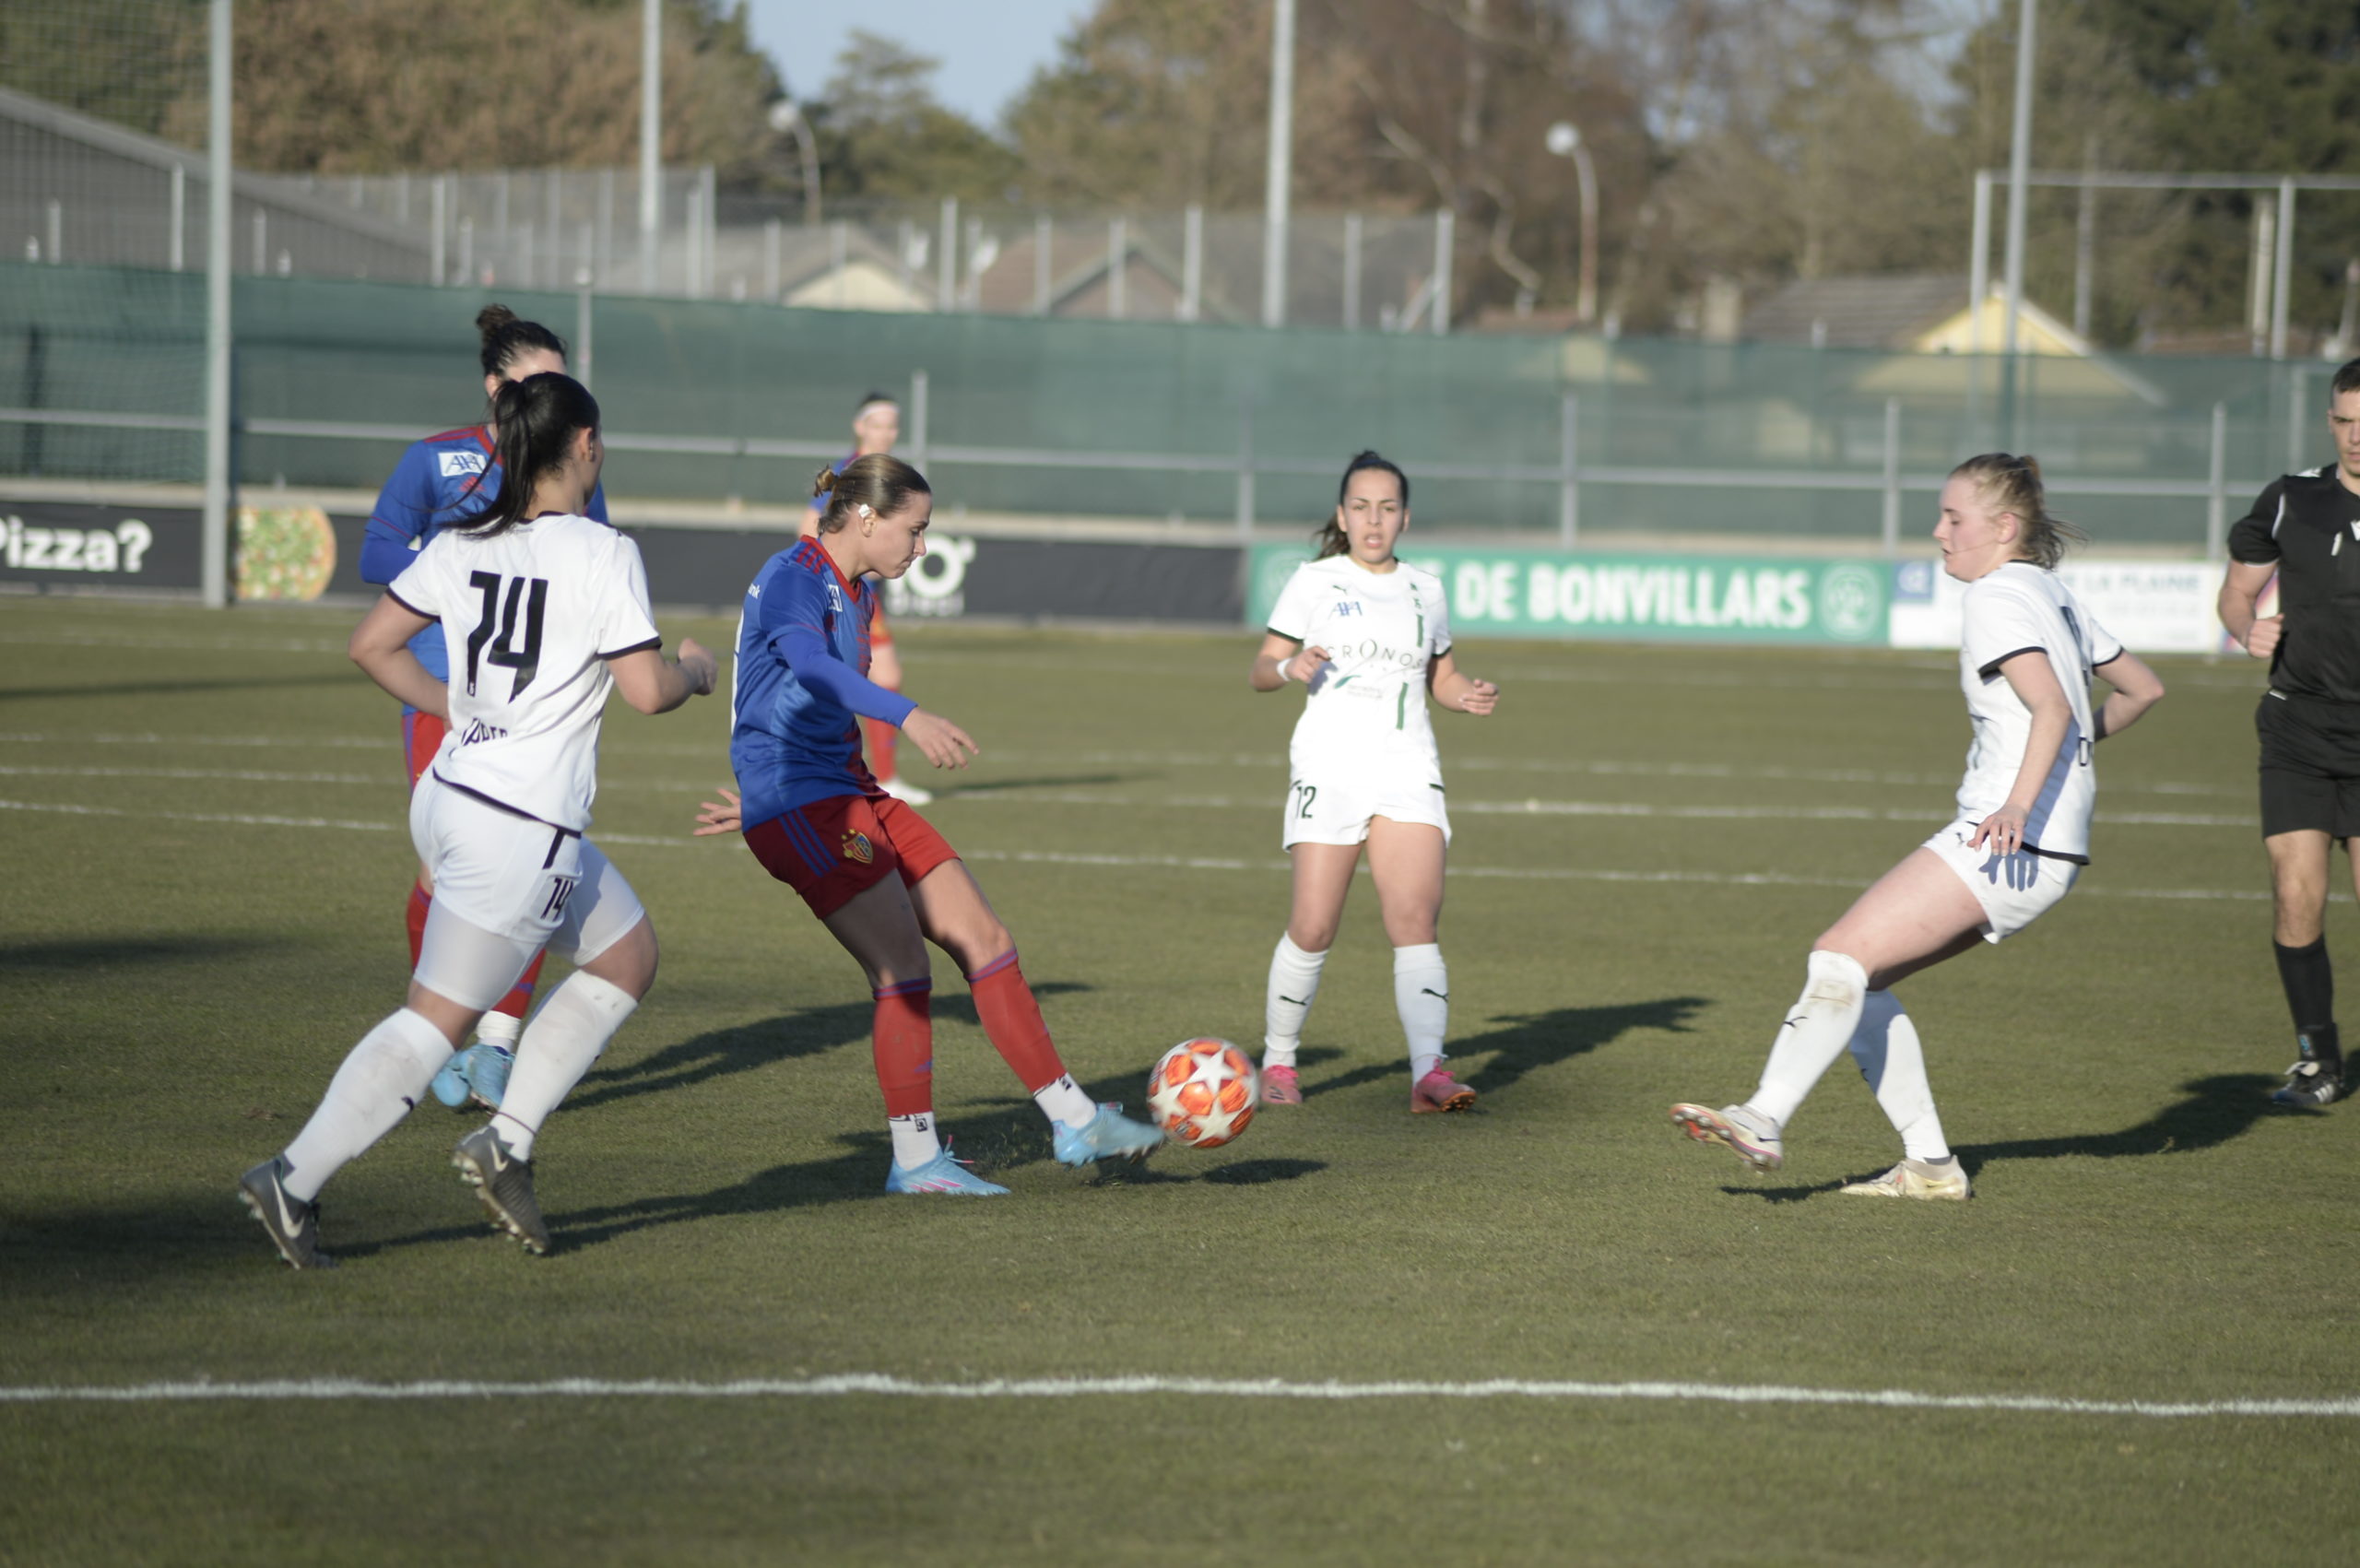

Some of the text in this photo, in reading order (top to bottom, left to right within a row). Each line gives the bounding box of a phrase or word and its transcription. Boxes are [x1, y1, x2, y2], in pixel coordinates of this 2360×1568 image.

[443, 454, 485, 474] AXA
[0, 515, 152, 572] izza?
[1454, 559, 1812, 630] DE BONVILLARS
[466, 570, 549, 704] 14
[1295, 785, 1317, 819] 12
[540, 877, 574, 923] 14
